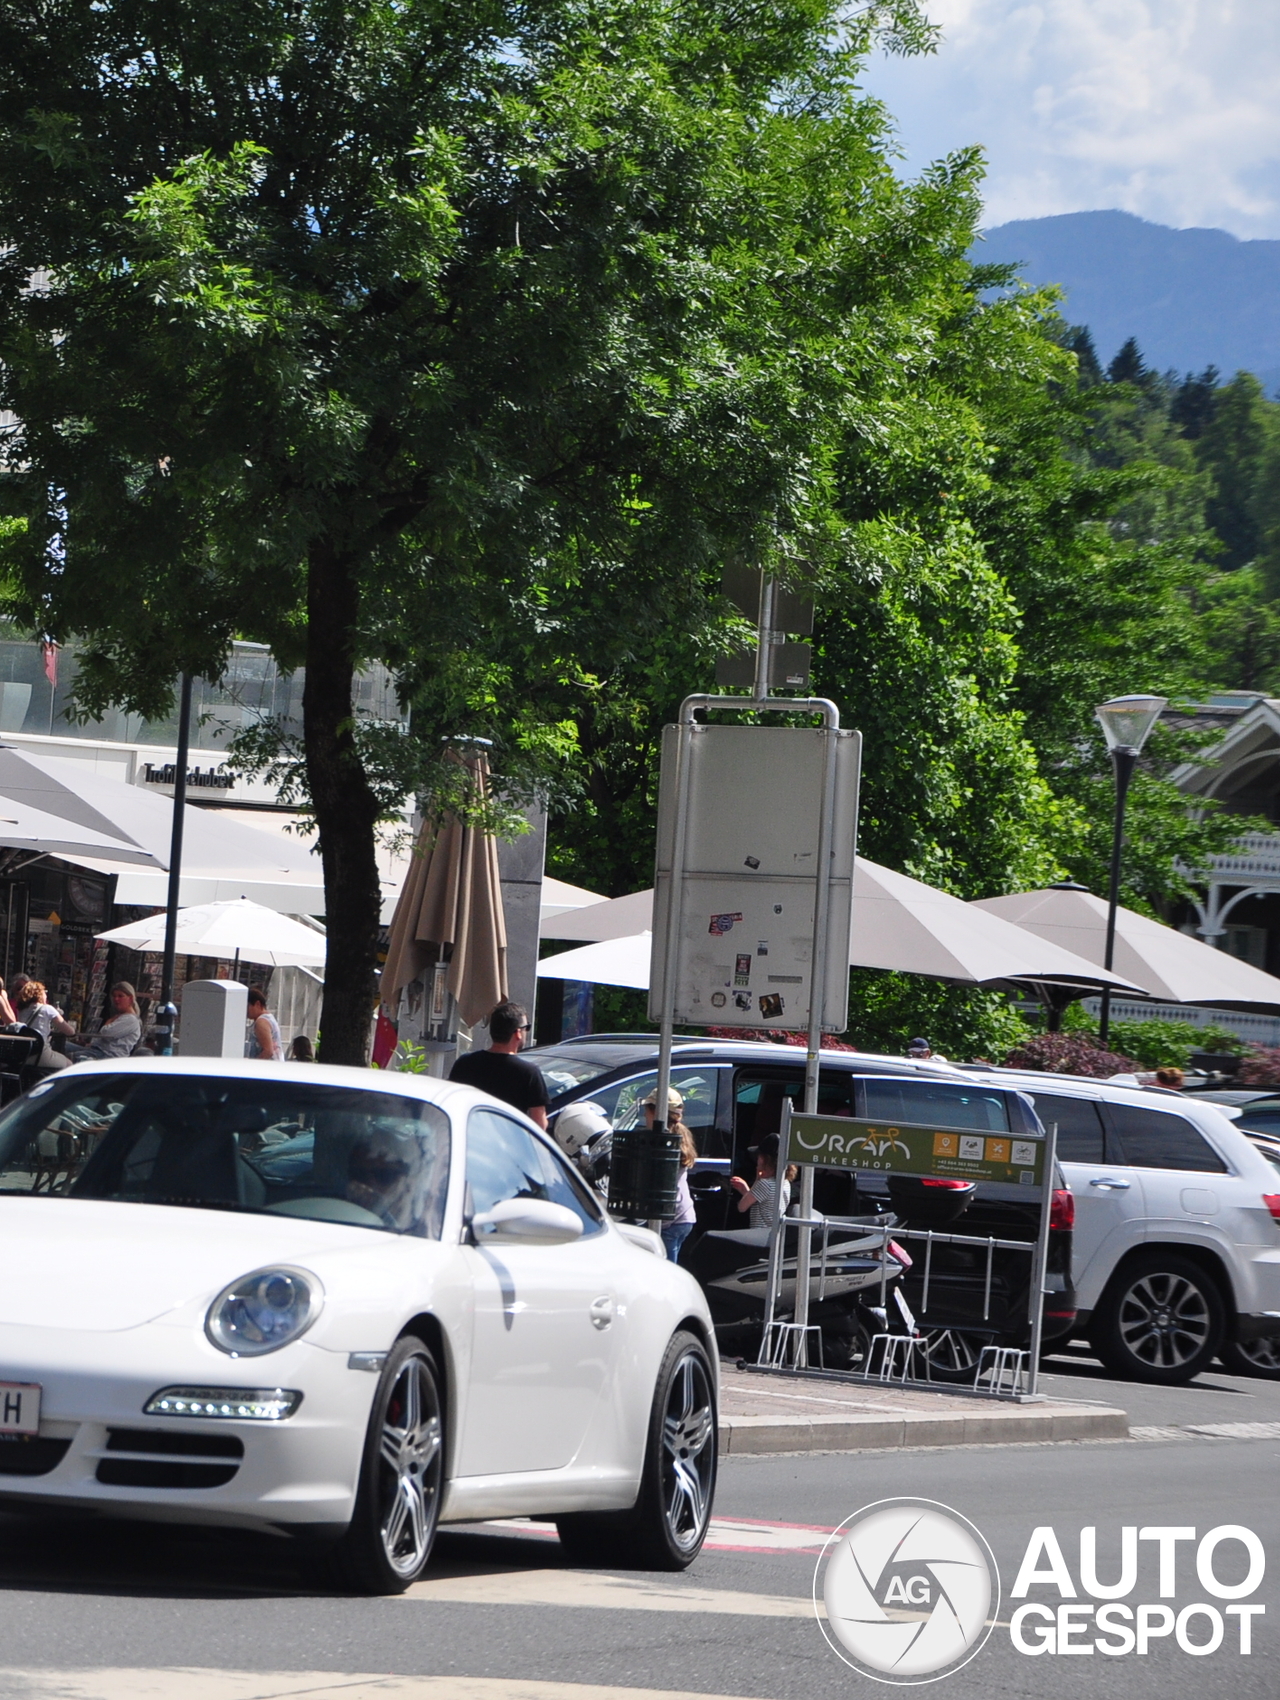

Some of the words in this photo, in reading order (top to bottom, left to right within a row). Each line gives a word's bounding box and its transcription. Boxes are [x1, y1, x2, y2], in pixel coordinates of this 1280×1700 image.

[142, 763, 177, 785] Trafi
[185, 765, 235, 789] chubet
[812, 1154, 892, 1170] BIKESHOP
